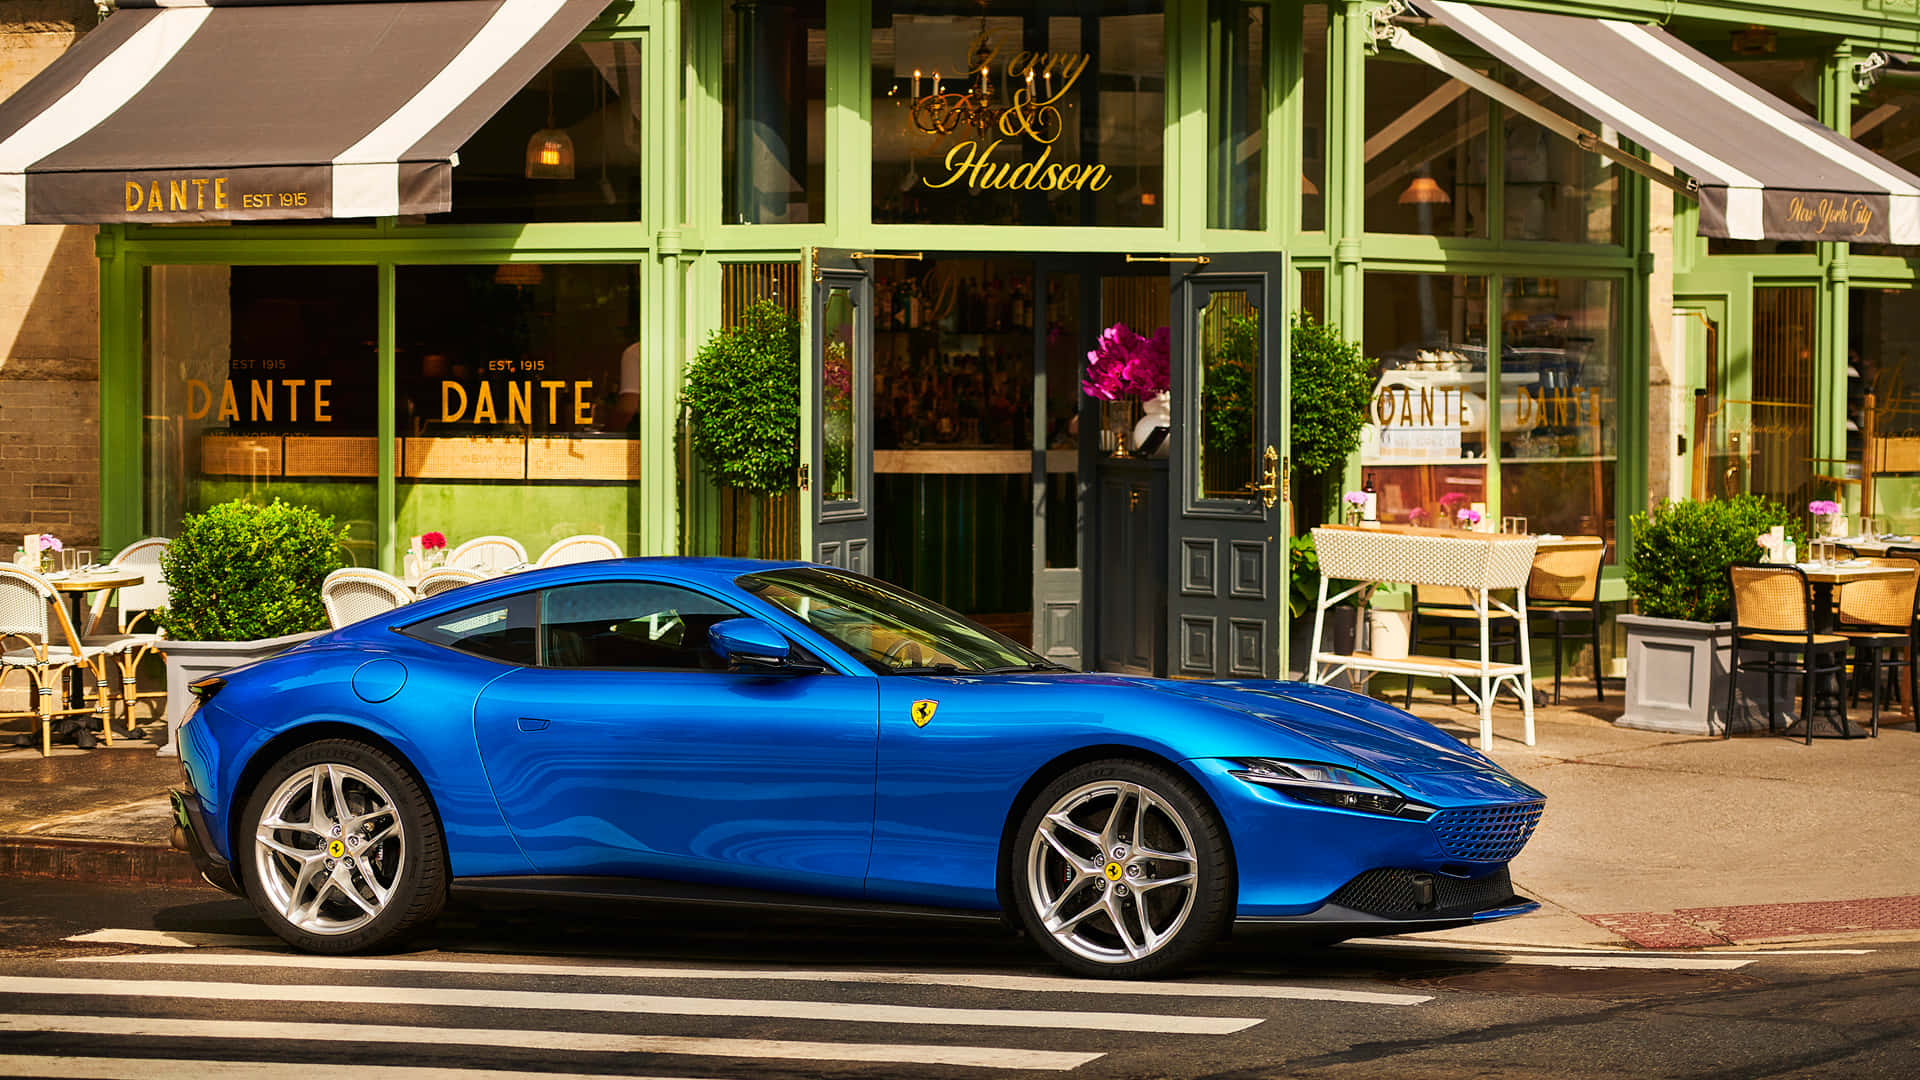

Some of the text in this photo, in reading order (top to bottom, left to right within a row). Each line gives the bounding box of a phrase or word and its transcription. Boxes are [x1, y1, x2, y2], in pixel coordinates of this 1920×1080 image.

[999, 88, 1062, 143] &
[922, 139, 1112, 191] Hudson
[125, 177, 308, 212] DANTE EST 1915
[1785, 196, 1873, 237] New York City
[232, 359, 286, 370] EST 1915
[520, 360, 545, 371] 1915
[186, 379, 333, 422] DANTE
[441, 380, 593, 424] DANTE
[1379, 386, 1470, 427] DANTE
[1516, 386, 1601, 427] DANTE
